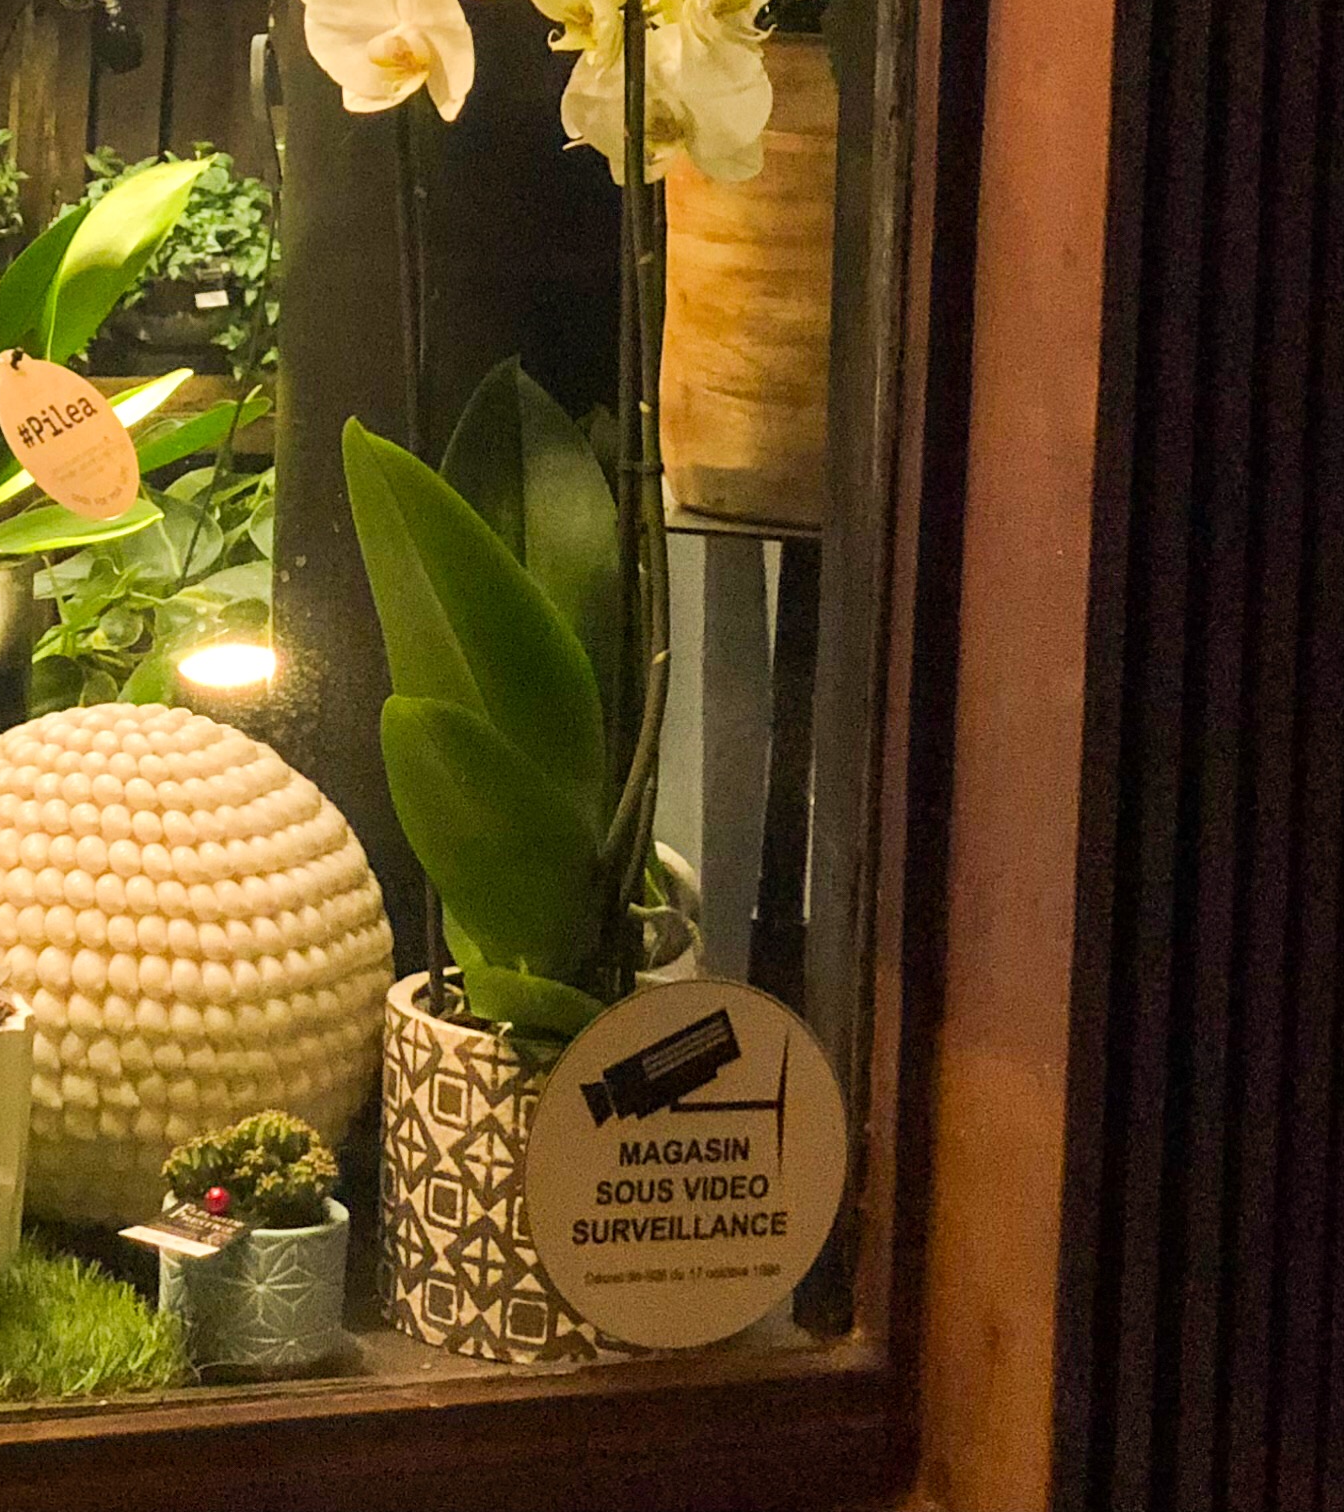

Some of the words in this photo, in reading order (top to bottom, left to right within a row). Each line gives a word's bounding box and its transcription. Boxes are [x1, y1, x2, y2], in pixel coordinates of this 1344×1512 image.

[16, 396, 98, 449] #Pilea
[618, 1136, 751, 1167] MAGASIN
[595, 1179, 674, 1206] SOUS
[683, 1174, 770, 1201] VIDEO
[571, 1211, 789, 1245] SURVEILLANCE
